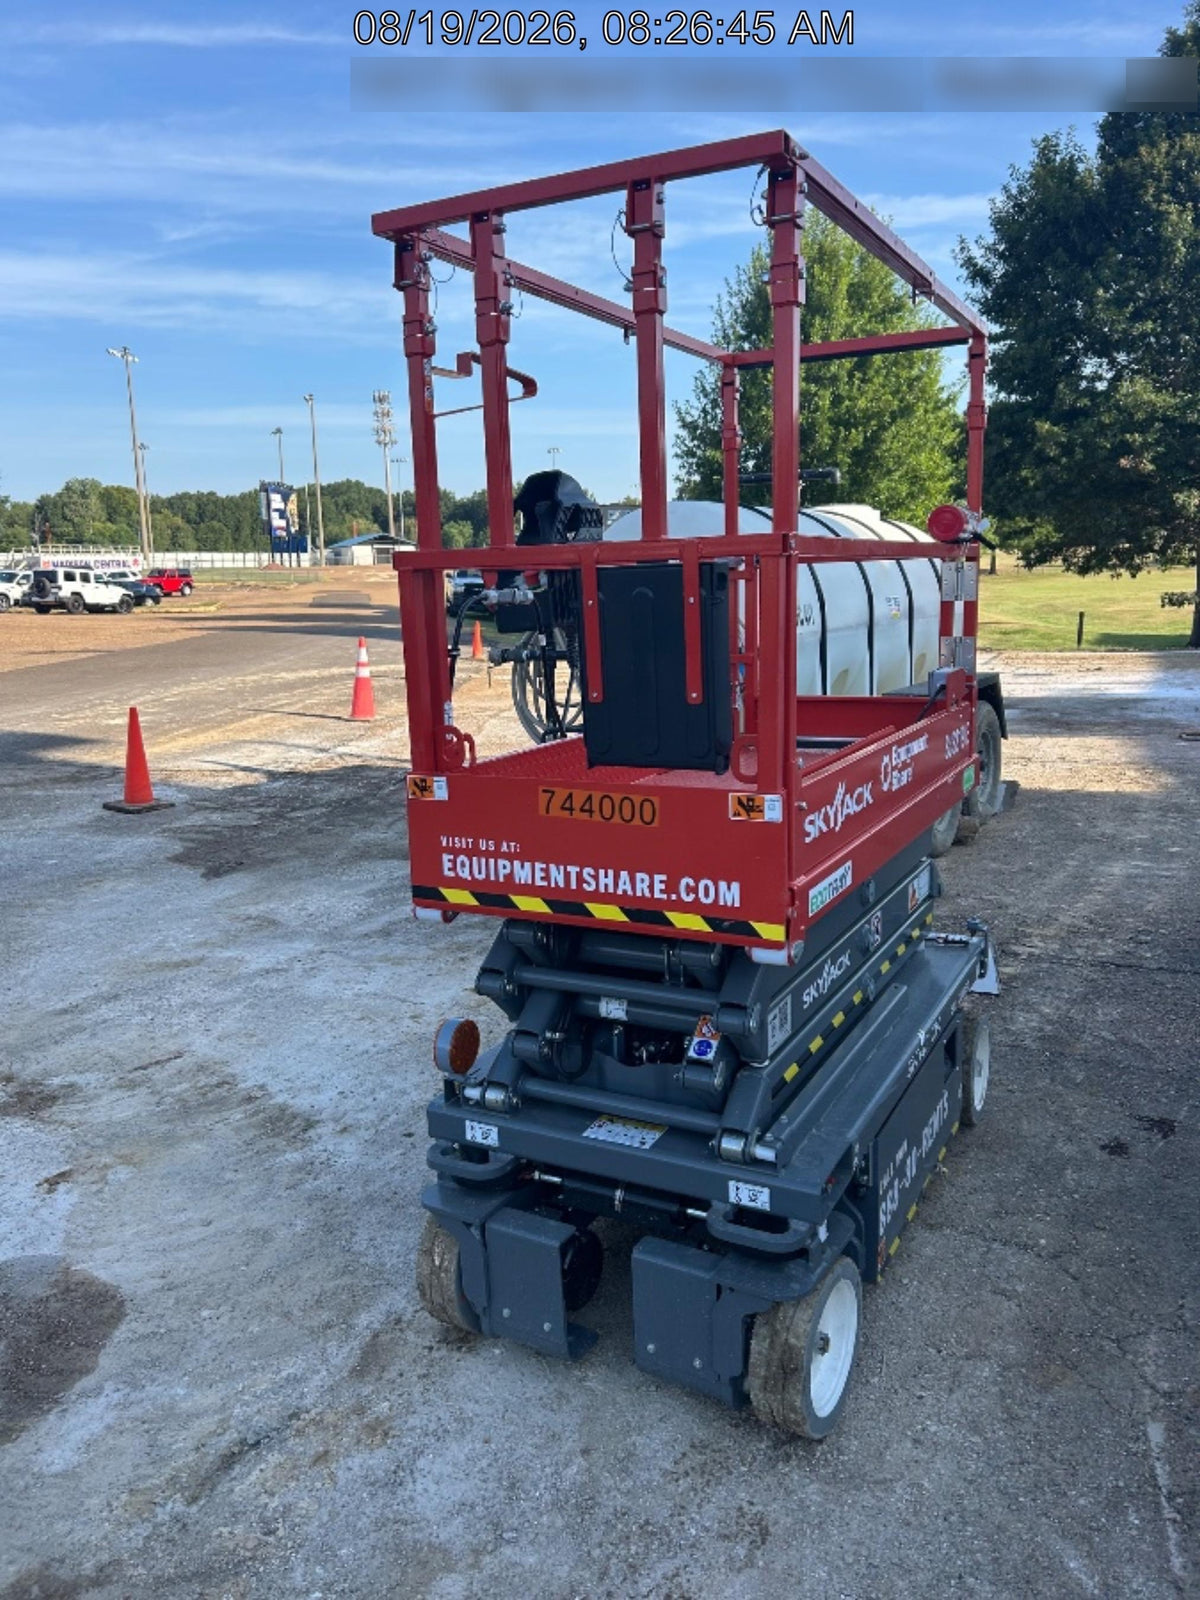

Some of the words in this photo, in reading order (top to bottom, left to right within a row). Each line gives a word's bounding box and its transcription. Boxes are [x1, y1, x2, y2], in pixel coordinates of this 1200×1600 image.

[541, 789, 657, 826] 744000
[803, 782, 874, 843] SKYJACK
[440, 835, 474, 850] VISIT
[479, 838, 495, 851] US
[500, 840, 521, 853] AT:
[441, 853, 742, 908] EQUIPMENTSHARE.COM
[802, 948, 852, 1010] SKYJACK
